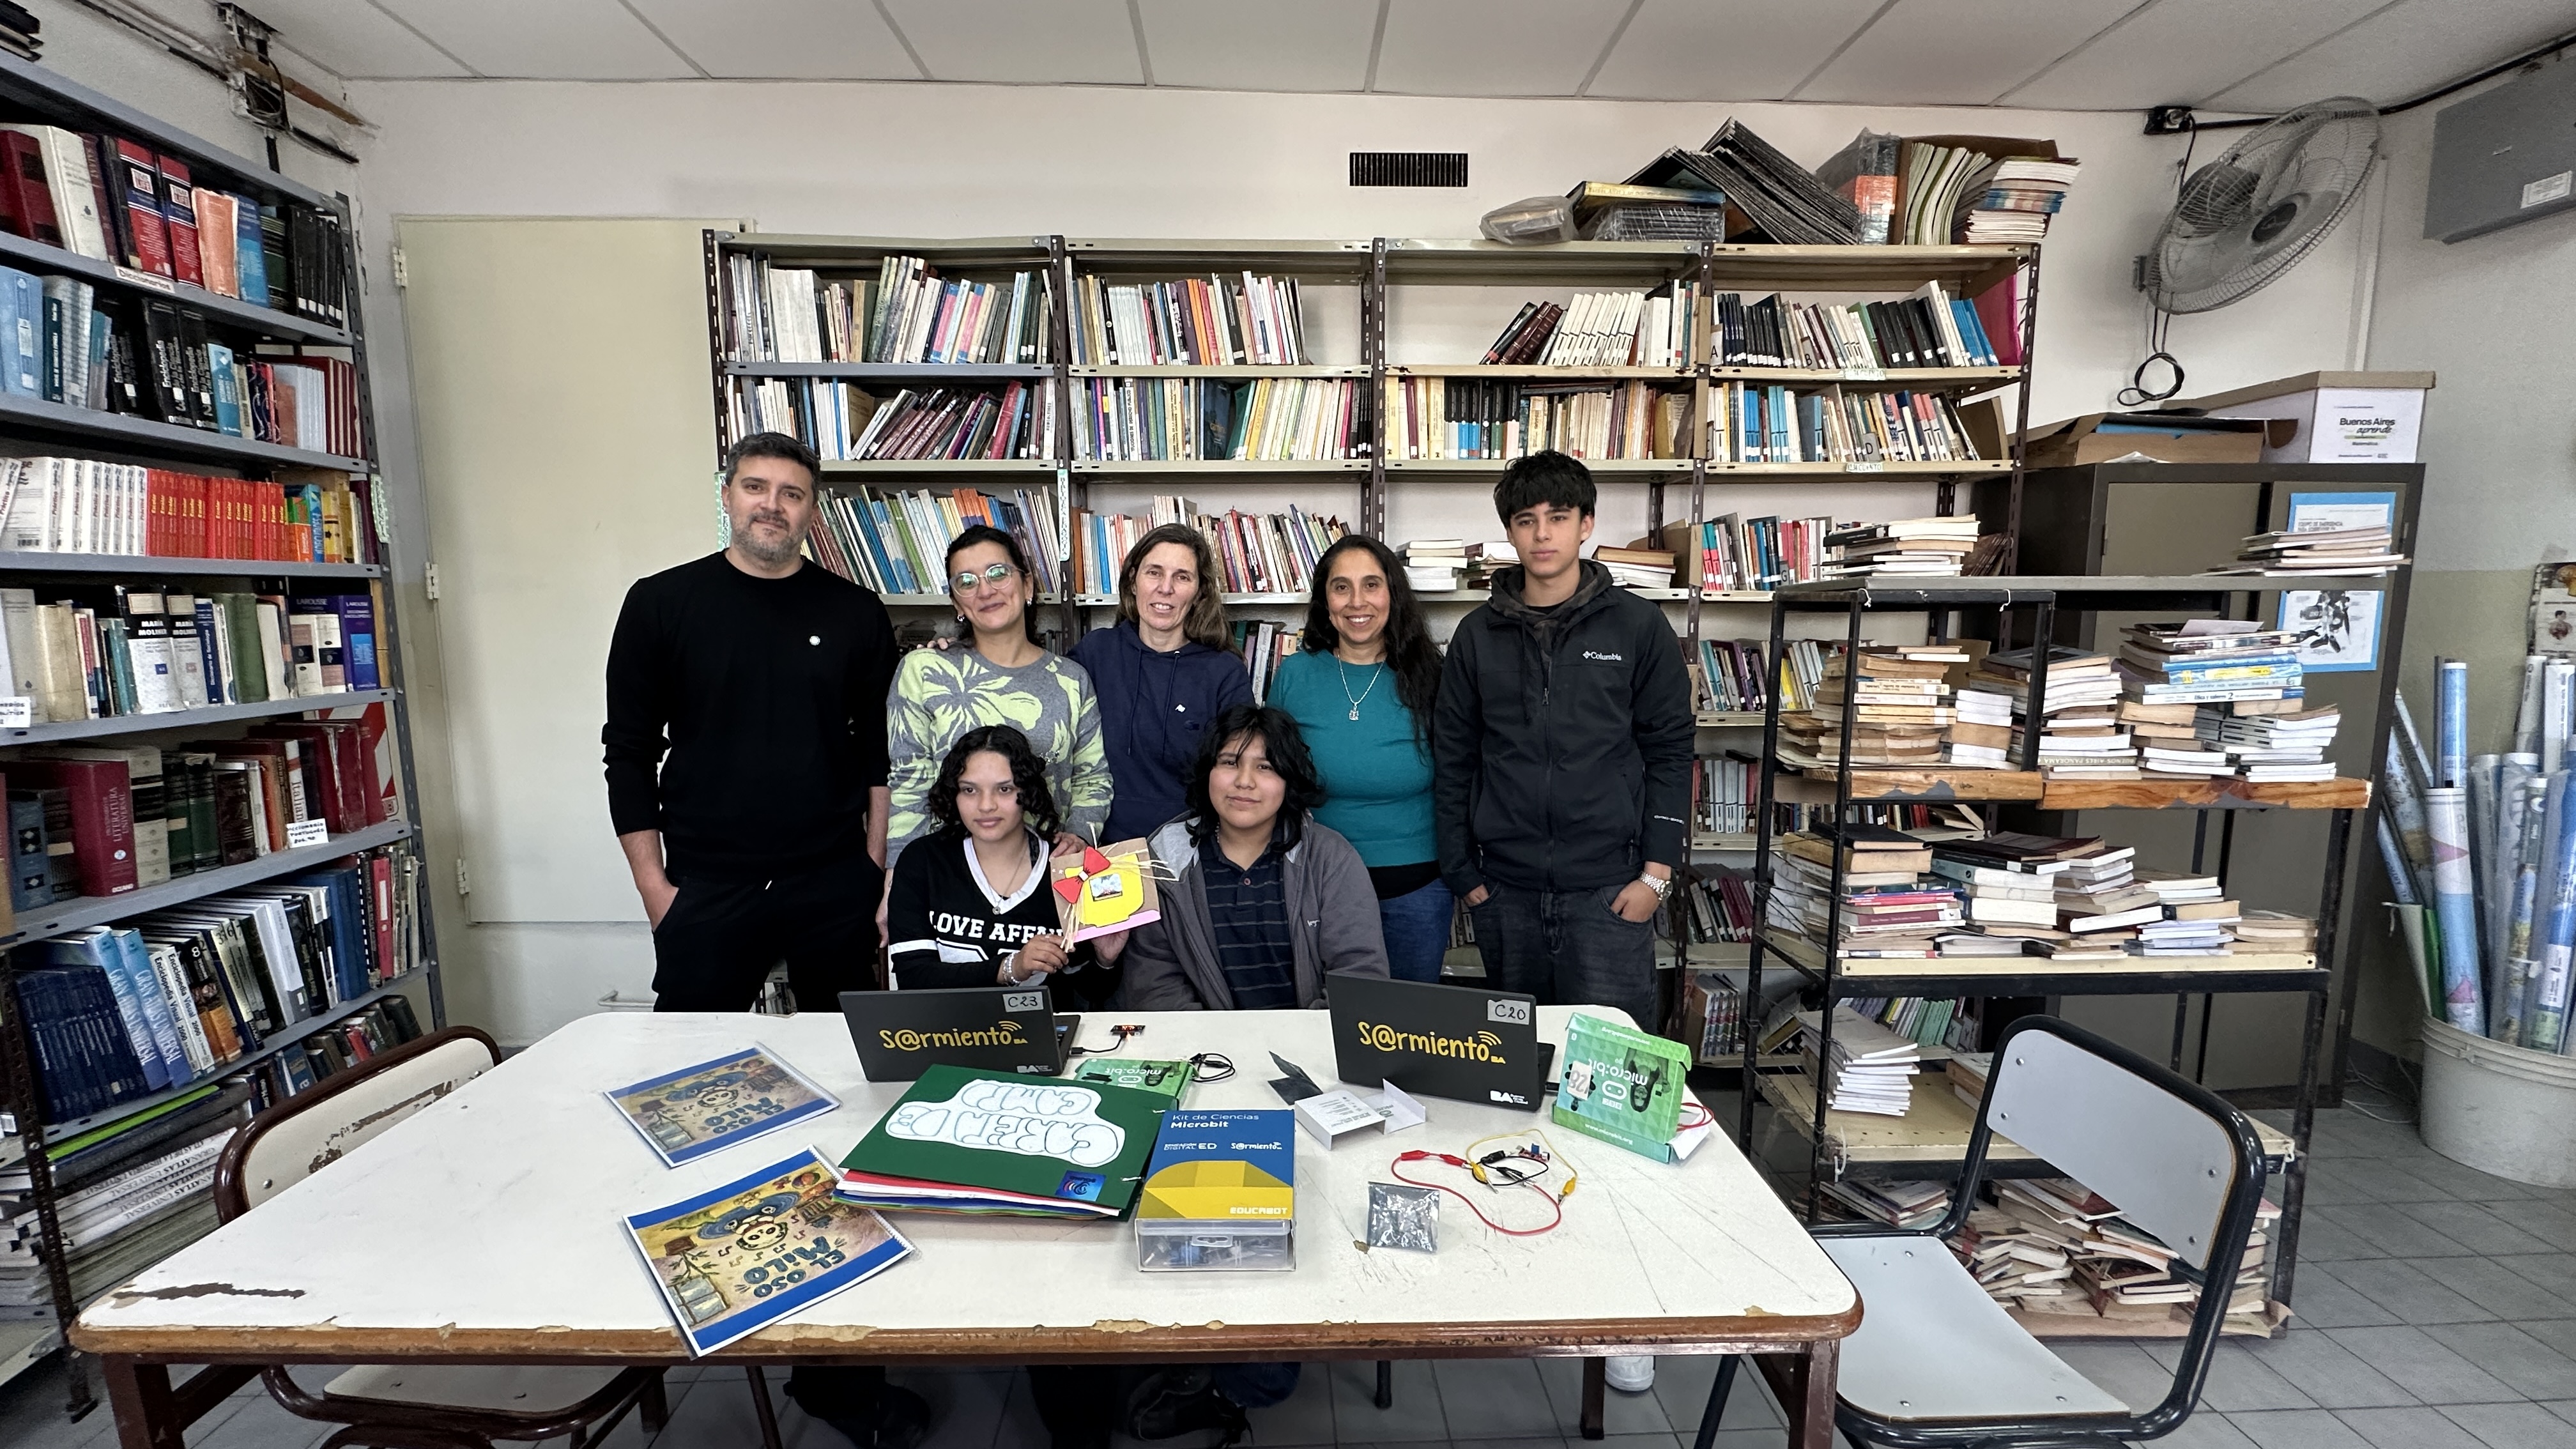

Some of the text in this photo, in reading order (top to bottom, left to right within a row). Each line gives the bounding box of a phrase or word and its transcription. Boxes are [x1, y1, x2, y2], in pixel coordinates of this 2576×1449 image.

[135, 178, 153, 194] LIFE
[172, 194, 190, 208] LIFE
[1710, 345, 1719, 359] A
[1804, 353, 1813, 366] B
[156, 340, 172, 388] Enciclopedia
[185, 346, 199, 393] Enciclopedia
[175, 400, 186, 411] 3
[203, 404, 213, 416] 2
[2372, 417, 2396, 426] Aires
[2356, 426, 2393, 436] aprende
[1865, 442, 1874, 455] D
[1781, 570, 1788, 582] G
[1590, 652, 1622, 661] Columbia
[291, 780, 305, 822] Italian
[109, 786, 123, 842] LITERATURA
[118, 792, 129, 834] UNIVERSAL
[192, 946, 201, 958] 8
[154, 956, 188, 1041] Enciclopedia Visual 2000
[168, 953, 201, 1036] Enciclopedia Visual 2000
[1008, 995, 1038, 1008] C23
[109, 969, 158, 1066] GRAN ATLAS UNIVERSAL
[135, 969, 182, 1065] GRAN ATLAS UNIVERSAL
[1494, 1004, 1526, 1020] C20
[879, 1027, 1013, 1051] S@rmiento
[1358, 1022, 1490, 1062] S@rmiento
[1588, 1058, 1649, 1086] micro:bit
[1490, 1090, 1514, 1104] BA
[756, 1104, 785, 1116] EL
[712, 1116, 754, 1134] OSO
[1585, 1123, 1633, 1145] www.microbit.org
[887, 1105, 1119, 1165] CARPETA DE
[1230, 1142, 1278, 1151] S@rmiento
[162, 1156, 191, 1174] ATLAS
[107, 1170, 162, 1197] UNIVERSAL
[124, 1179, 200, 1220] ATLAS UNIVERSAL
[1229, 1206, 1288, 1215] EDUCABOT
[809, 1248, 847, 1269] EL
[753, 1269, 806, 1298] OSO
